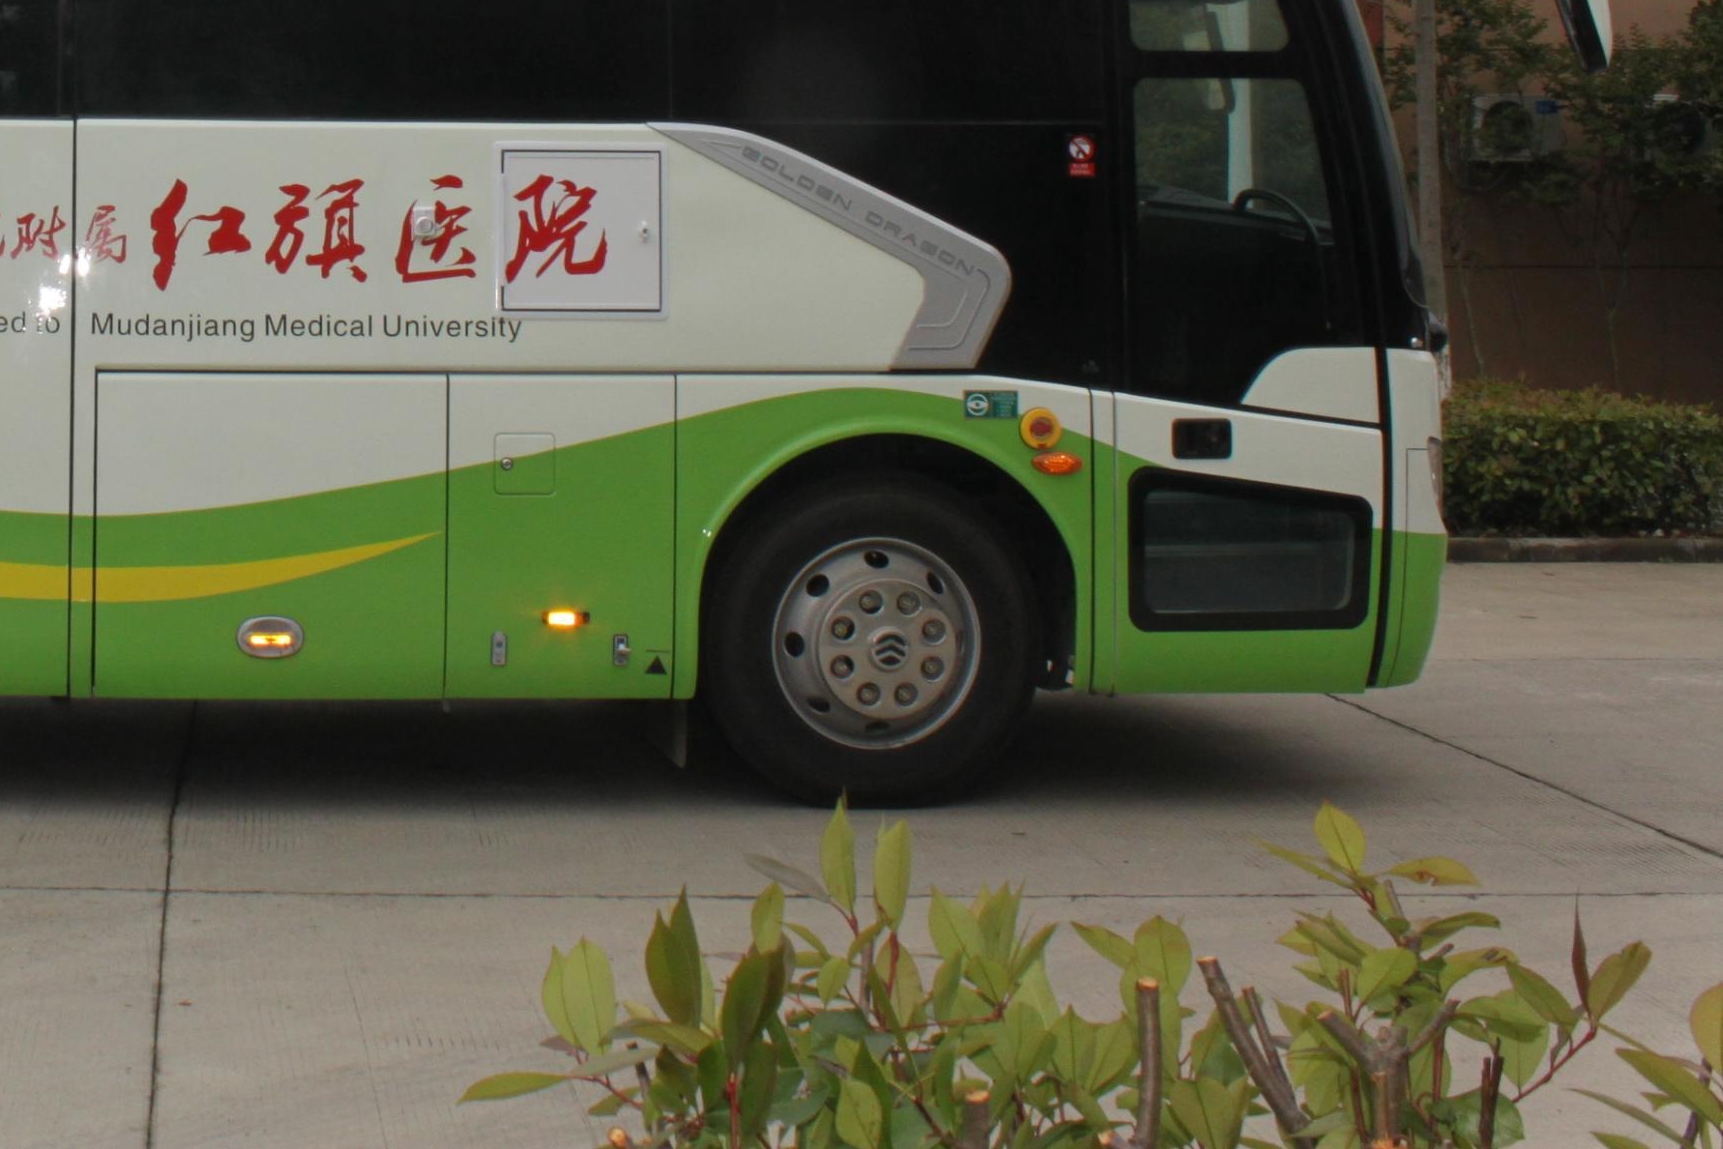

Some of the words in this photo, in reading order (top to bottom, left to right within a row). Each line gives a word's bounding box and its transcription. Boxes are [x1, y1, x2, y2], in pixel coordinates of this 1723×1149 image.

[150, 174, 608, 290] 红旗医院
[742, 147, 853, 211] GOLDEN
[865, 211, 977, 276] DRAGON
[92, 313, 254, 342] Mudanjiang
[265, 315, 372, 336] Medical
[382, 315, 522, 344] University
